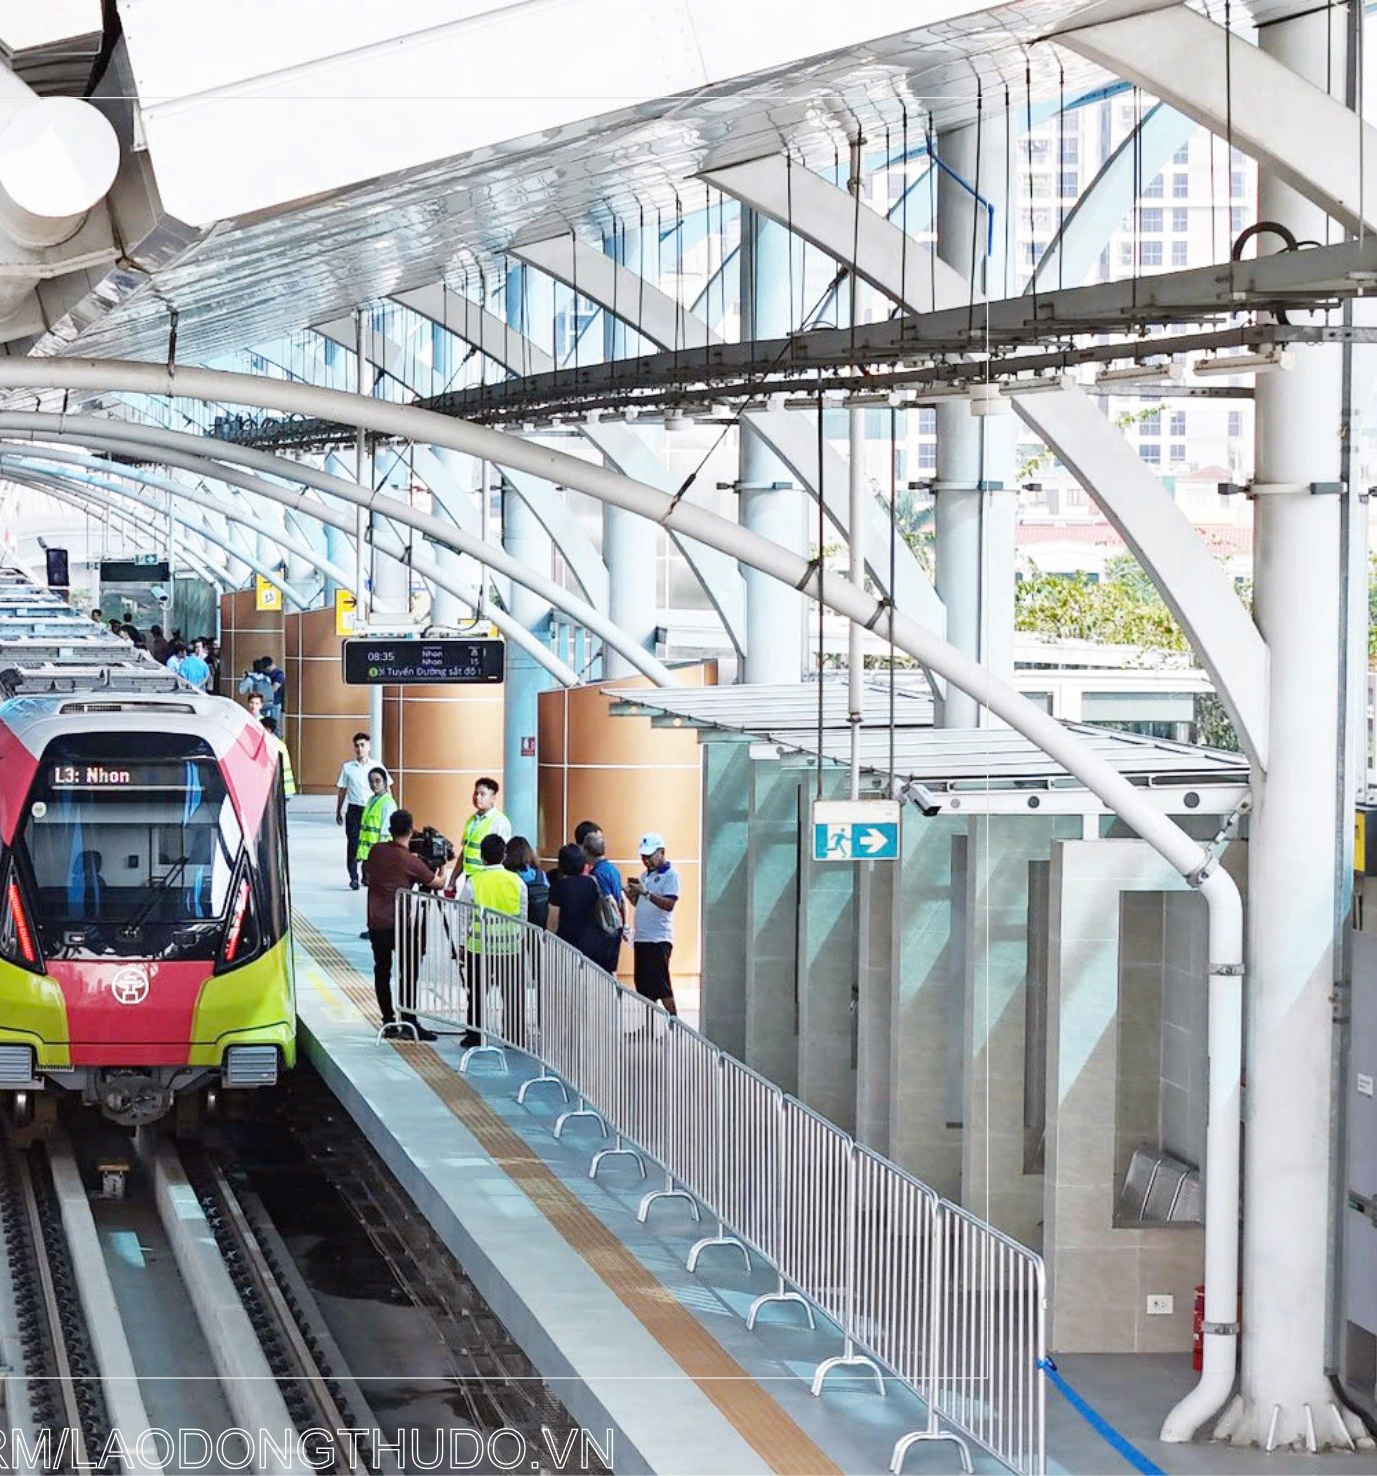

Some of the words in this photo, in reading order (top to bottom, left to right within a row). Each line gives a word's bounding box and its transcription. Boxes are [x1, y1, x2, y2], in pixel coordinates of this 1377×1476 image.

[367, 651, 395, 661] 08:35
[54, 767, 80, 783] L3:
[86, 767, 131, 783] Nhon
